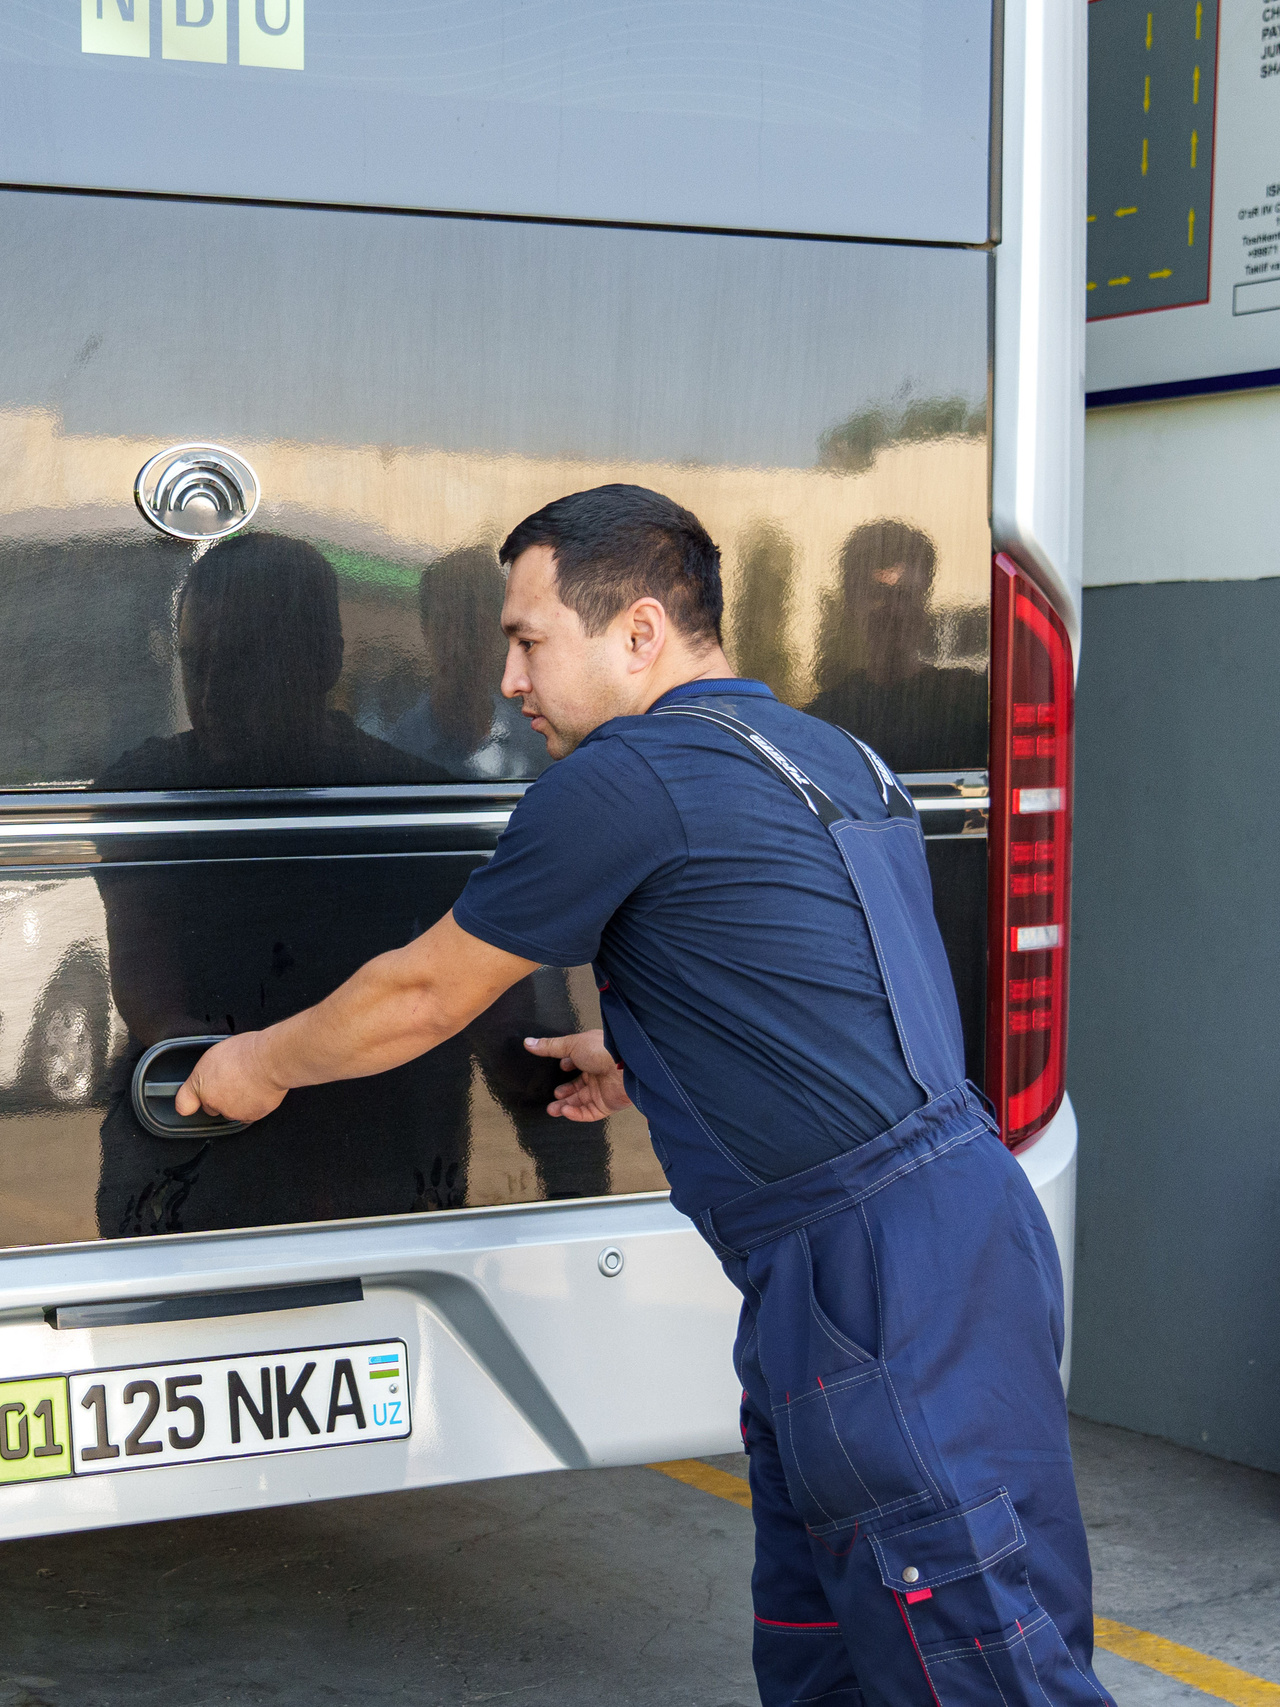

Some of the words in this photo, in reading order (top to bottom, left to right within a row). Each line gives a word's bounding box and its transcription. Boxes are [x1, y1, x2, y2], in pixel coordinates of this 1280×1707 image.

[81, 1374, 205, 1461] 125
[227, 1358, 367, 1444] NKA
[373, 1401, 403, 1426] UZ
